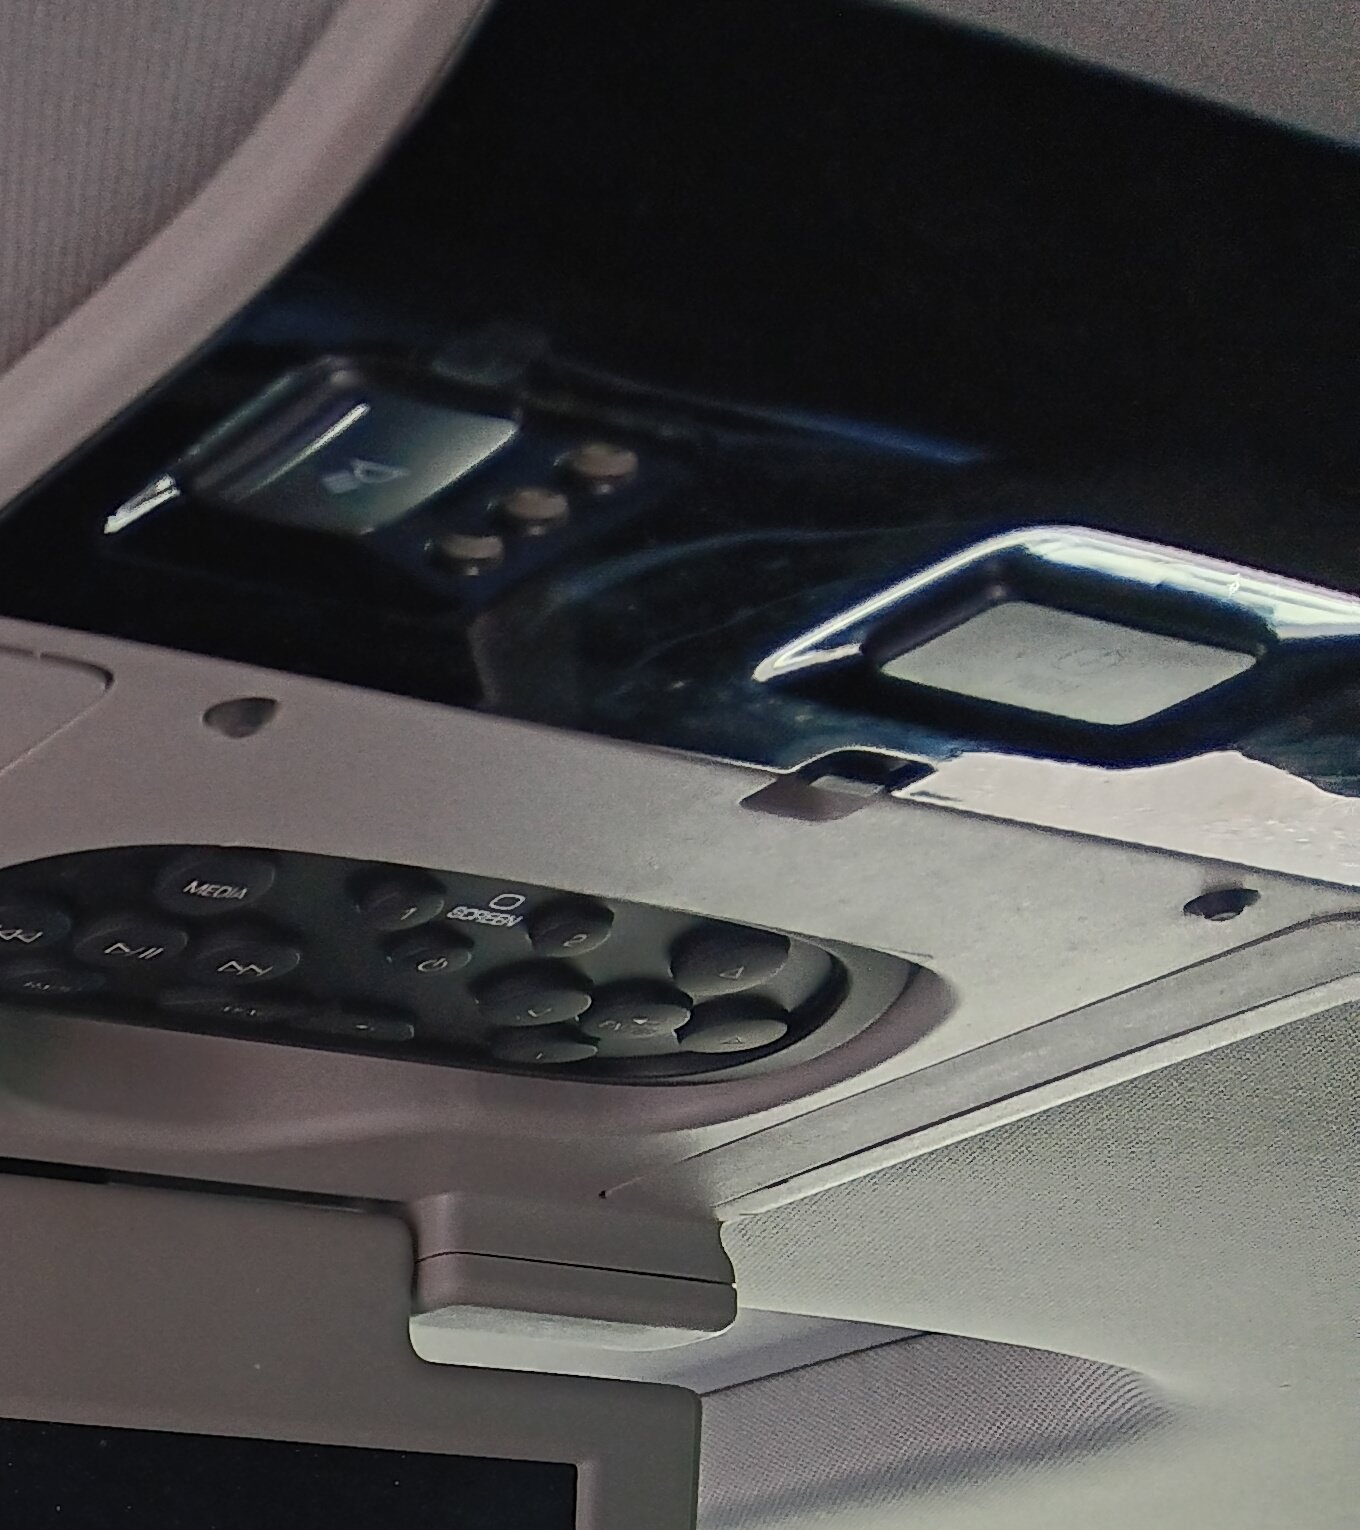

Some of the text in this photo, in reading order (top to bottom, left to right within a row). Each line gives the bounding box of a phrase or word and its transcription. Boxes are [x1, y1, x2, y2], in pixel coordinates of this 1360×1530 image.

[183, 880, 248, 900] MEDIA
[400, 906, 418, 921] 1
[446, 905, 524, 928] SCREEN
[563, 933, 588, 948] 2
